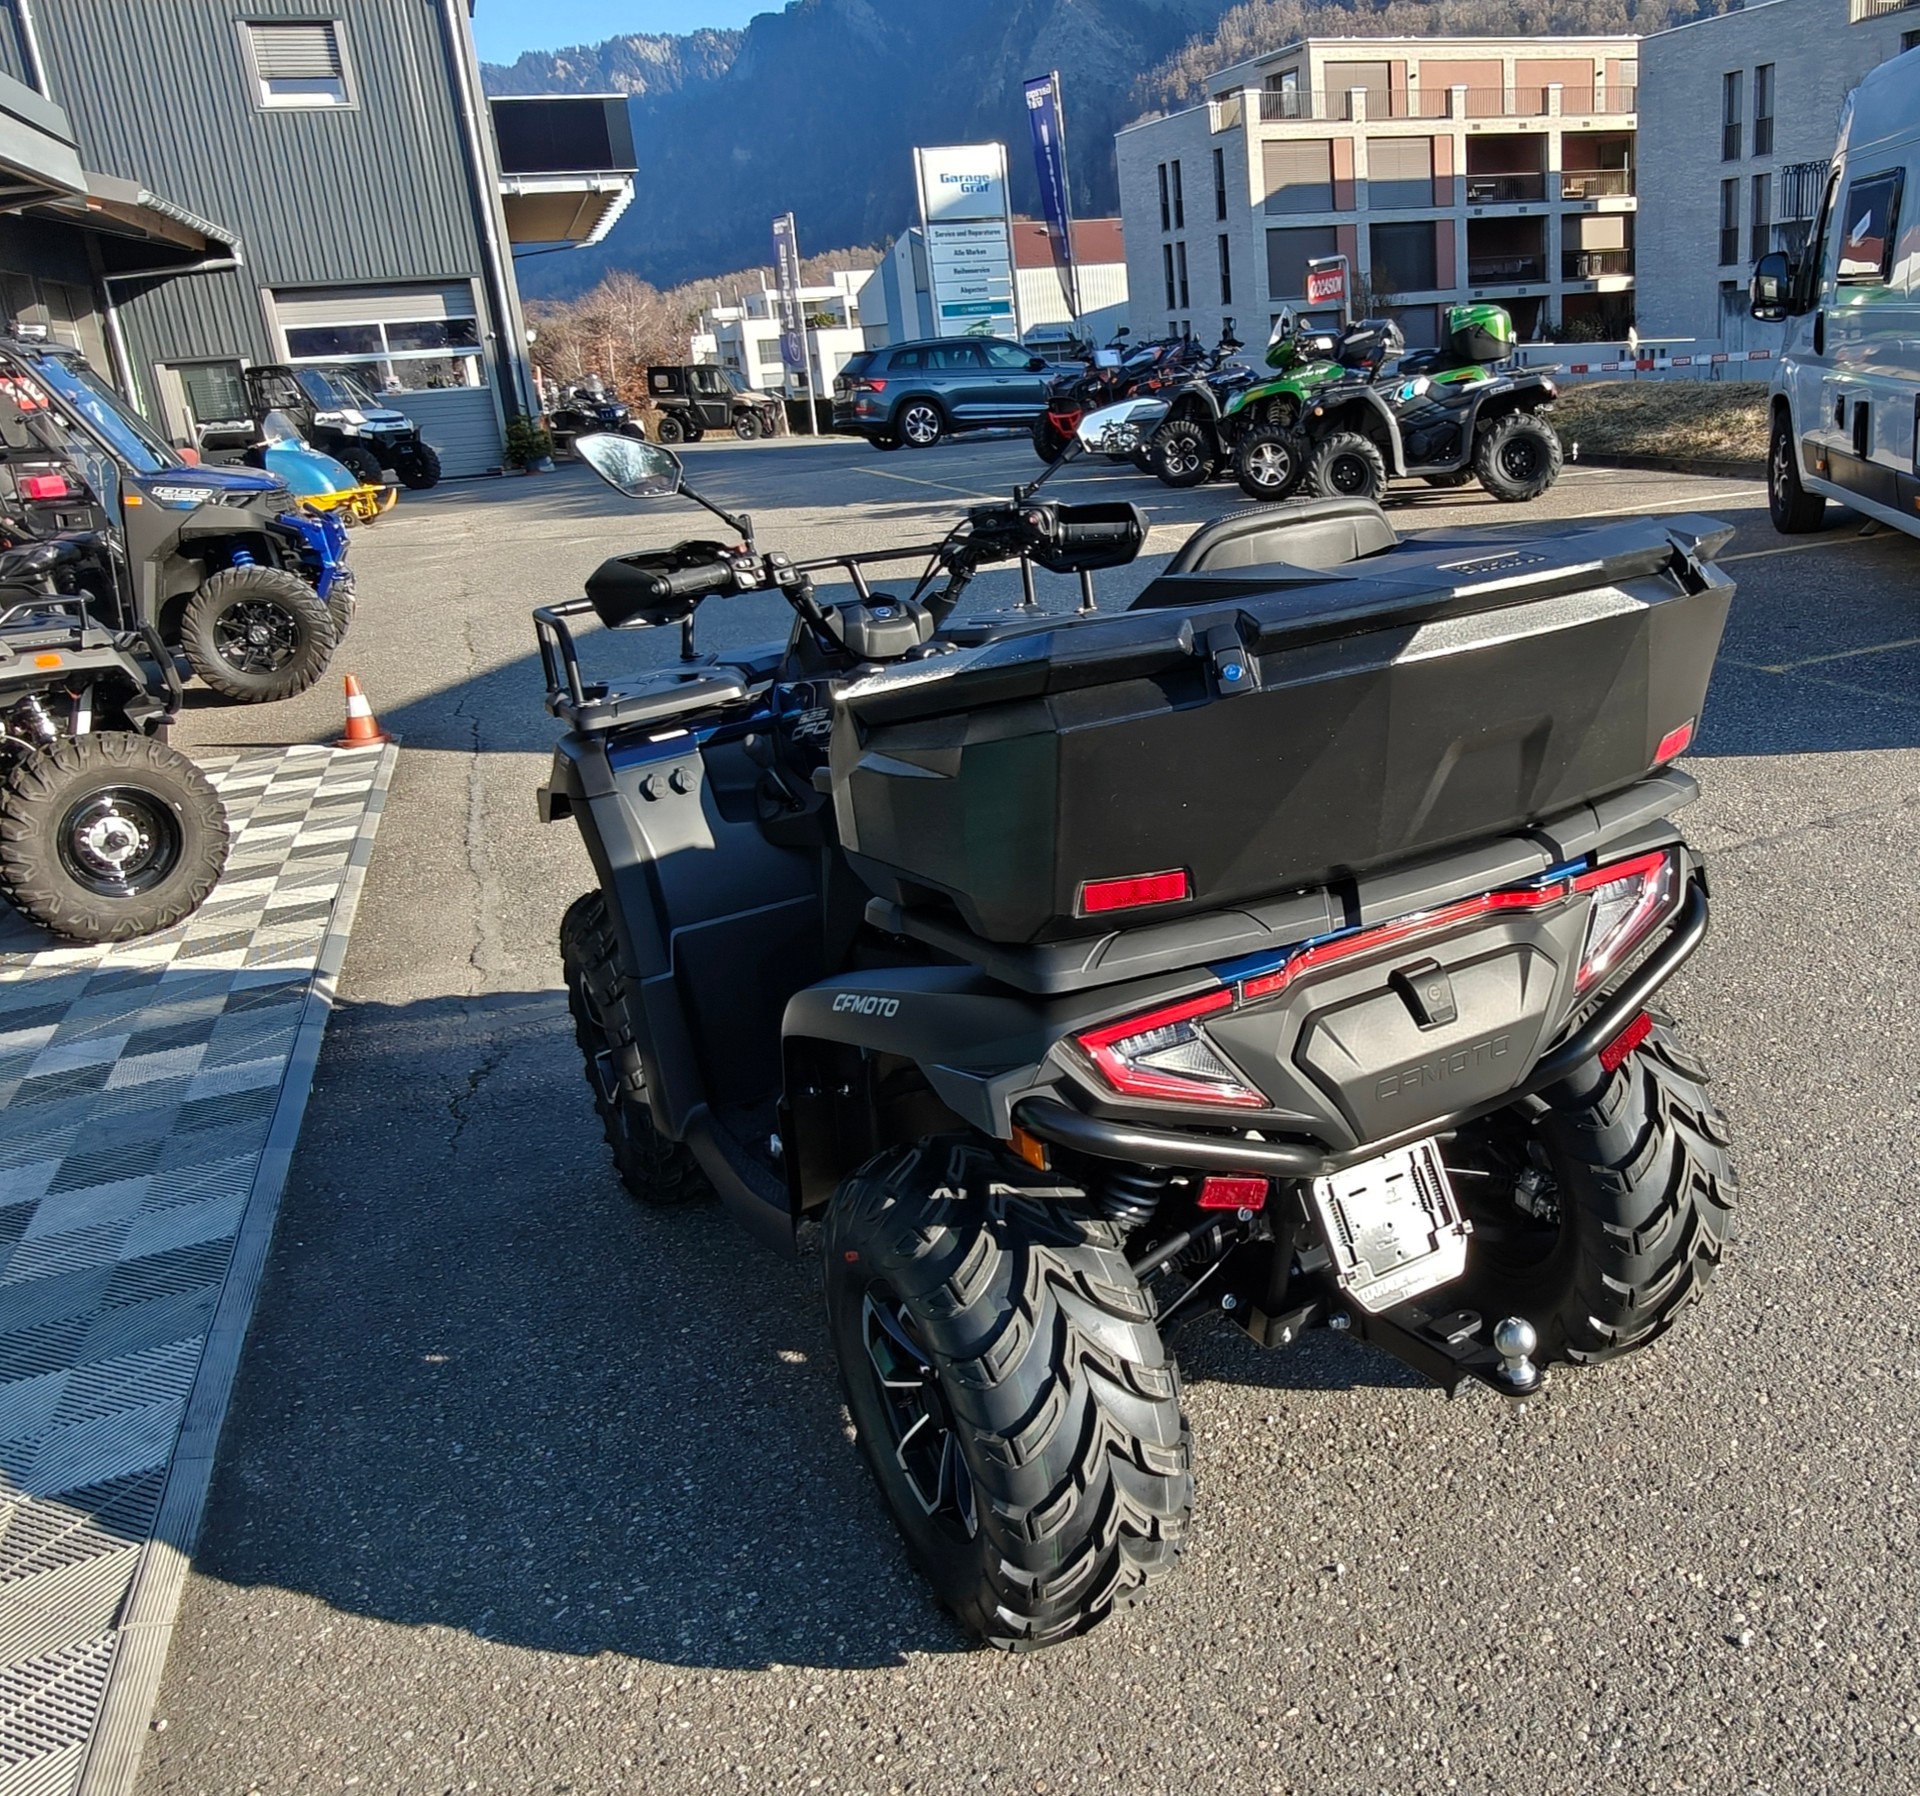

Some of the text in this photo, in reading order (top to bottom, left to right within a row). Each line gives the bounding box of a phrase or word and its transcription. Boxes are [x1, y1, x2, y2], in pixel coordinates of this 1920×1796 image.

[940, 173, 991, 185] Garage
[960, 183, 990, 193] Graf
[1310, 276, 1342, 298] OCCASION
[151, 486, 213, 499] 1000
[792, 720, 833, 740] CFO
[832, 993, 900, 1017] CFMOTO
[1375, 1034, 1511, 1102] CFMOTO
